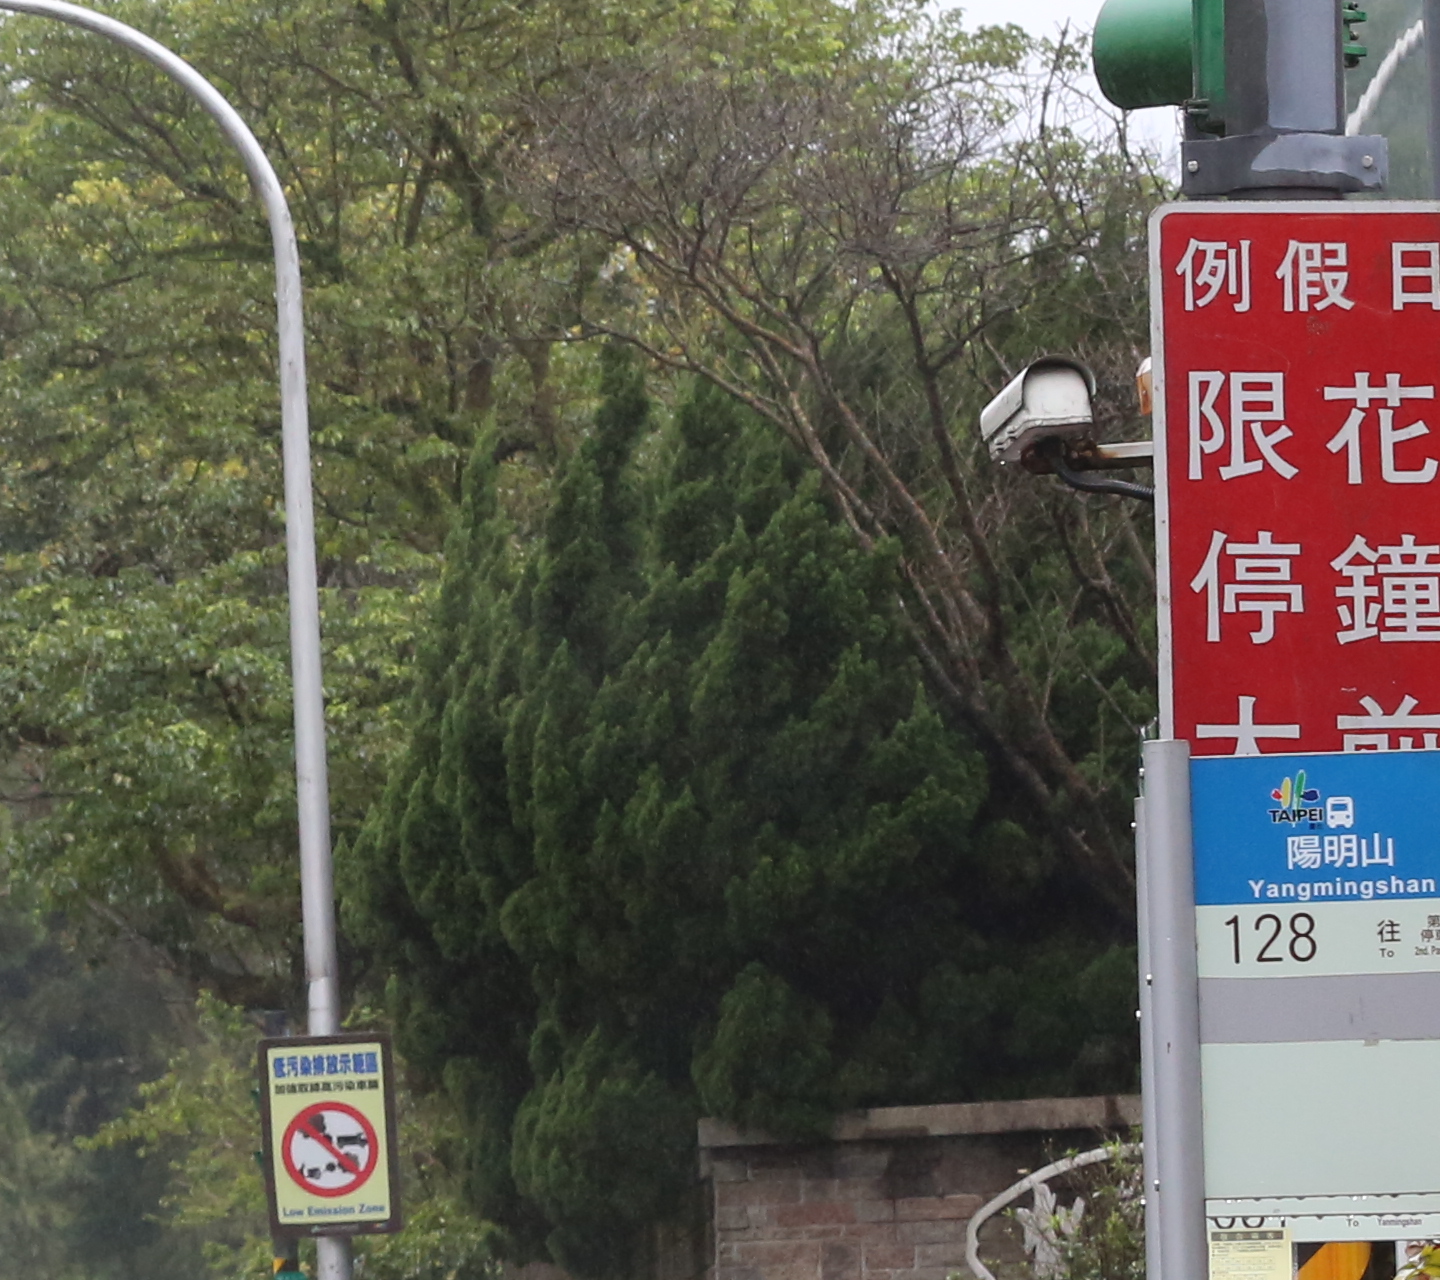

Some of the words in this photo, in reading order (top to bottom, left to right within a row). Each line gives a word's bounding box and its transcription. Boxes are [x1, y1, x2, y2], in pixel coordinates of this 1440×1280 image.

[1177, 238, 1440, 312] 例假日
[1269, 808, 1323, 823] TAIPEI
[1287, 833, 1394, 869] 陽明山
[1248, 875, 1436, 901] Yangmingshan
[1225, 913, 1317, 964] 128
[1377, 919, 1401, 943] 往
[1379, 948, 1395, 958] To
[283, 1206, 304, 1217] Low
[308, 1205, 355, 1216] Emission
[359, 1203, 385, 1214] Zone
[1346, 1219, 1360, 1227] To
